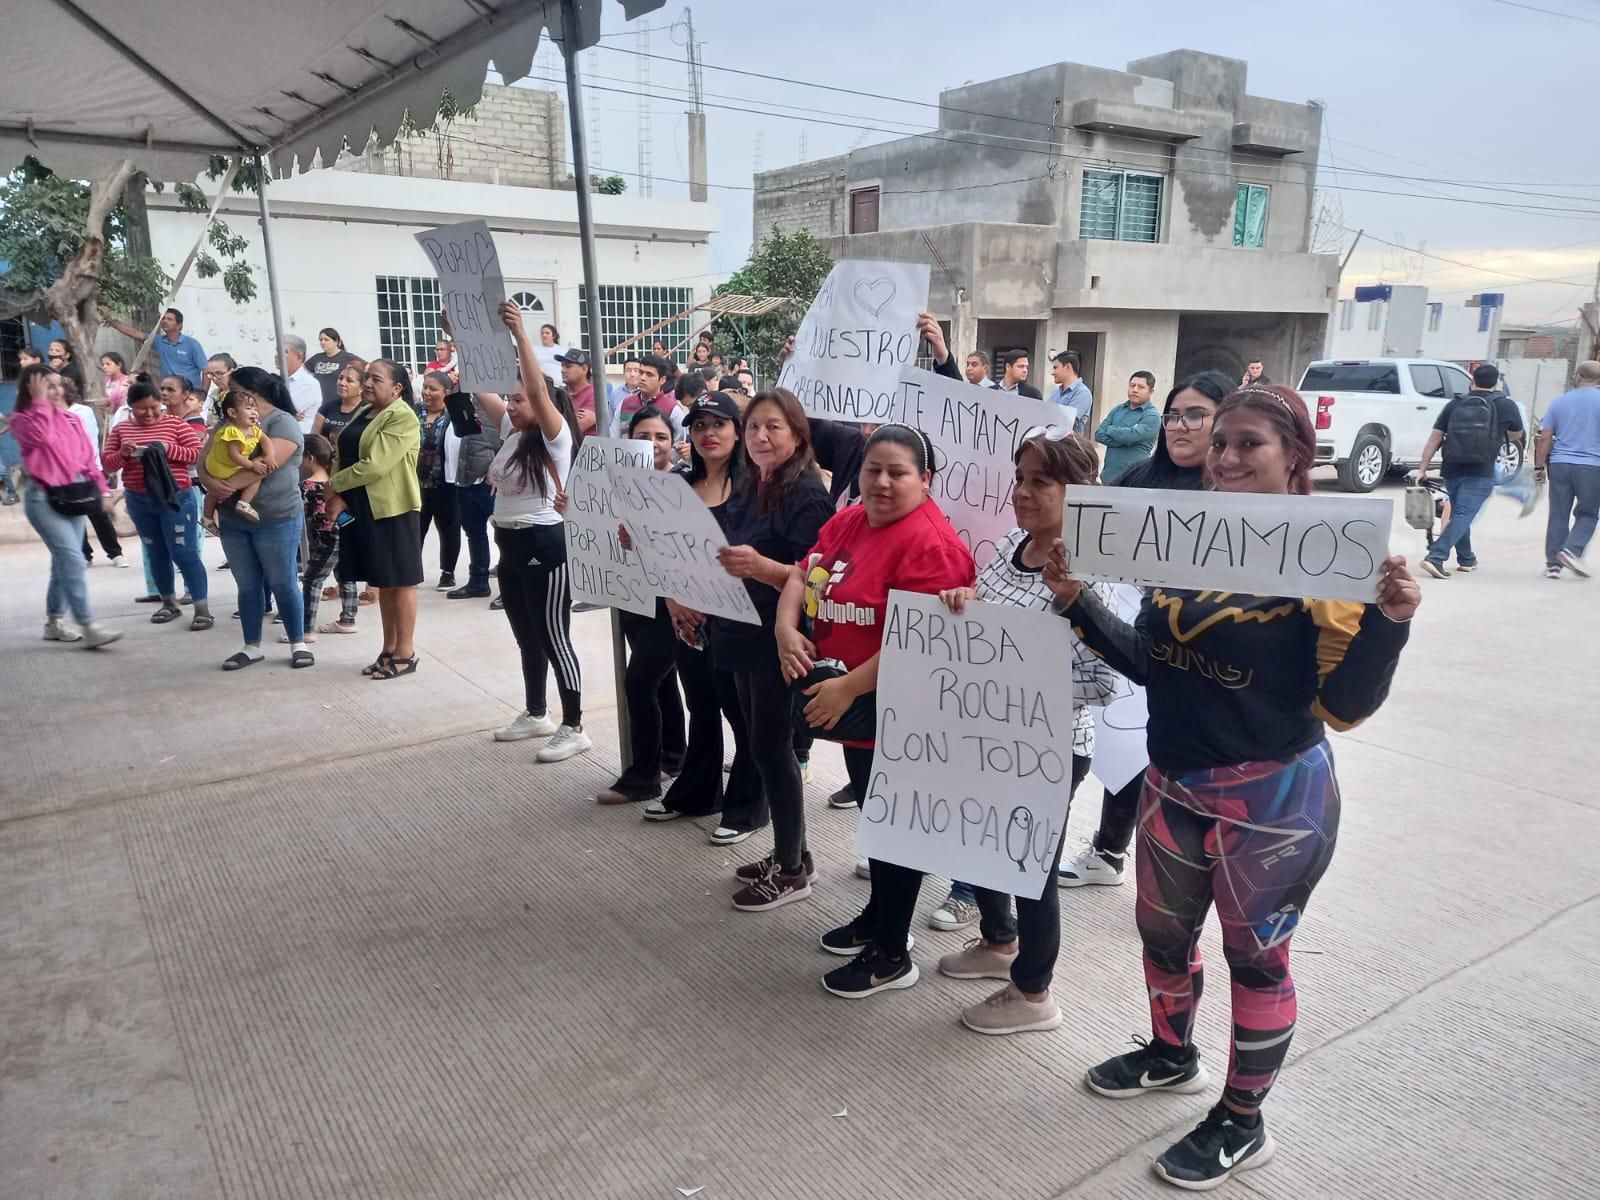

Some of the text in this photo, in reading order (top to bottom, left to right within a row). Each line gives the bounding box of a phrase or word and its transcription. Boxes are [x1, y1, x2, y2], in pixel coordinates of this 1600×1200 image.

[442, 289, 495, 335] TEAM
[459, 342, 512, 386] ROCHA
[900, 380, 929, 435] TE
[567, 520, 601, 556] POR
[1068, 503, 1121, 558] TE
[1133, 504, 1376, 580] AMAMOS
[885, 603, 1024, 665] ARRIBA
[929, 667, 1053, 738] ROCHA
[880, 707, 1064, 784] CON TODO
